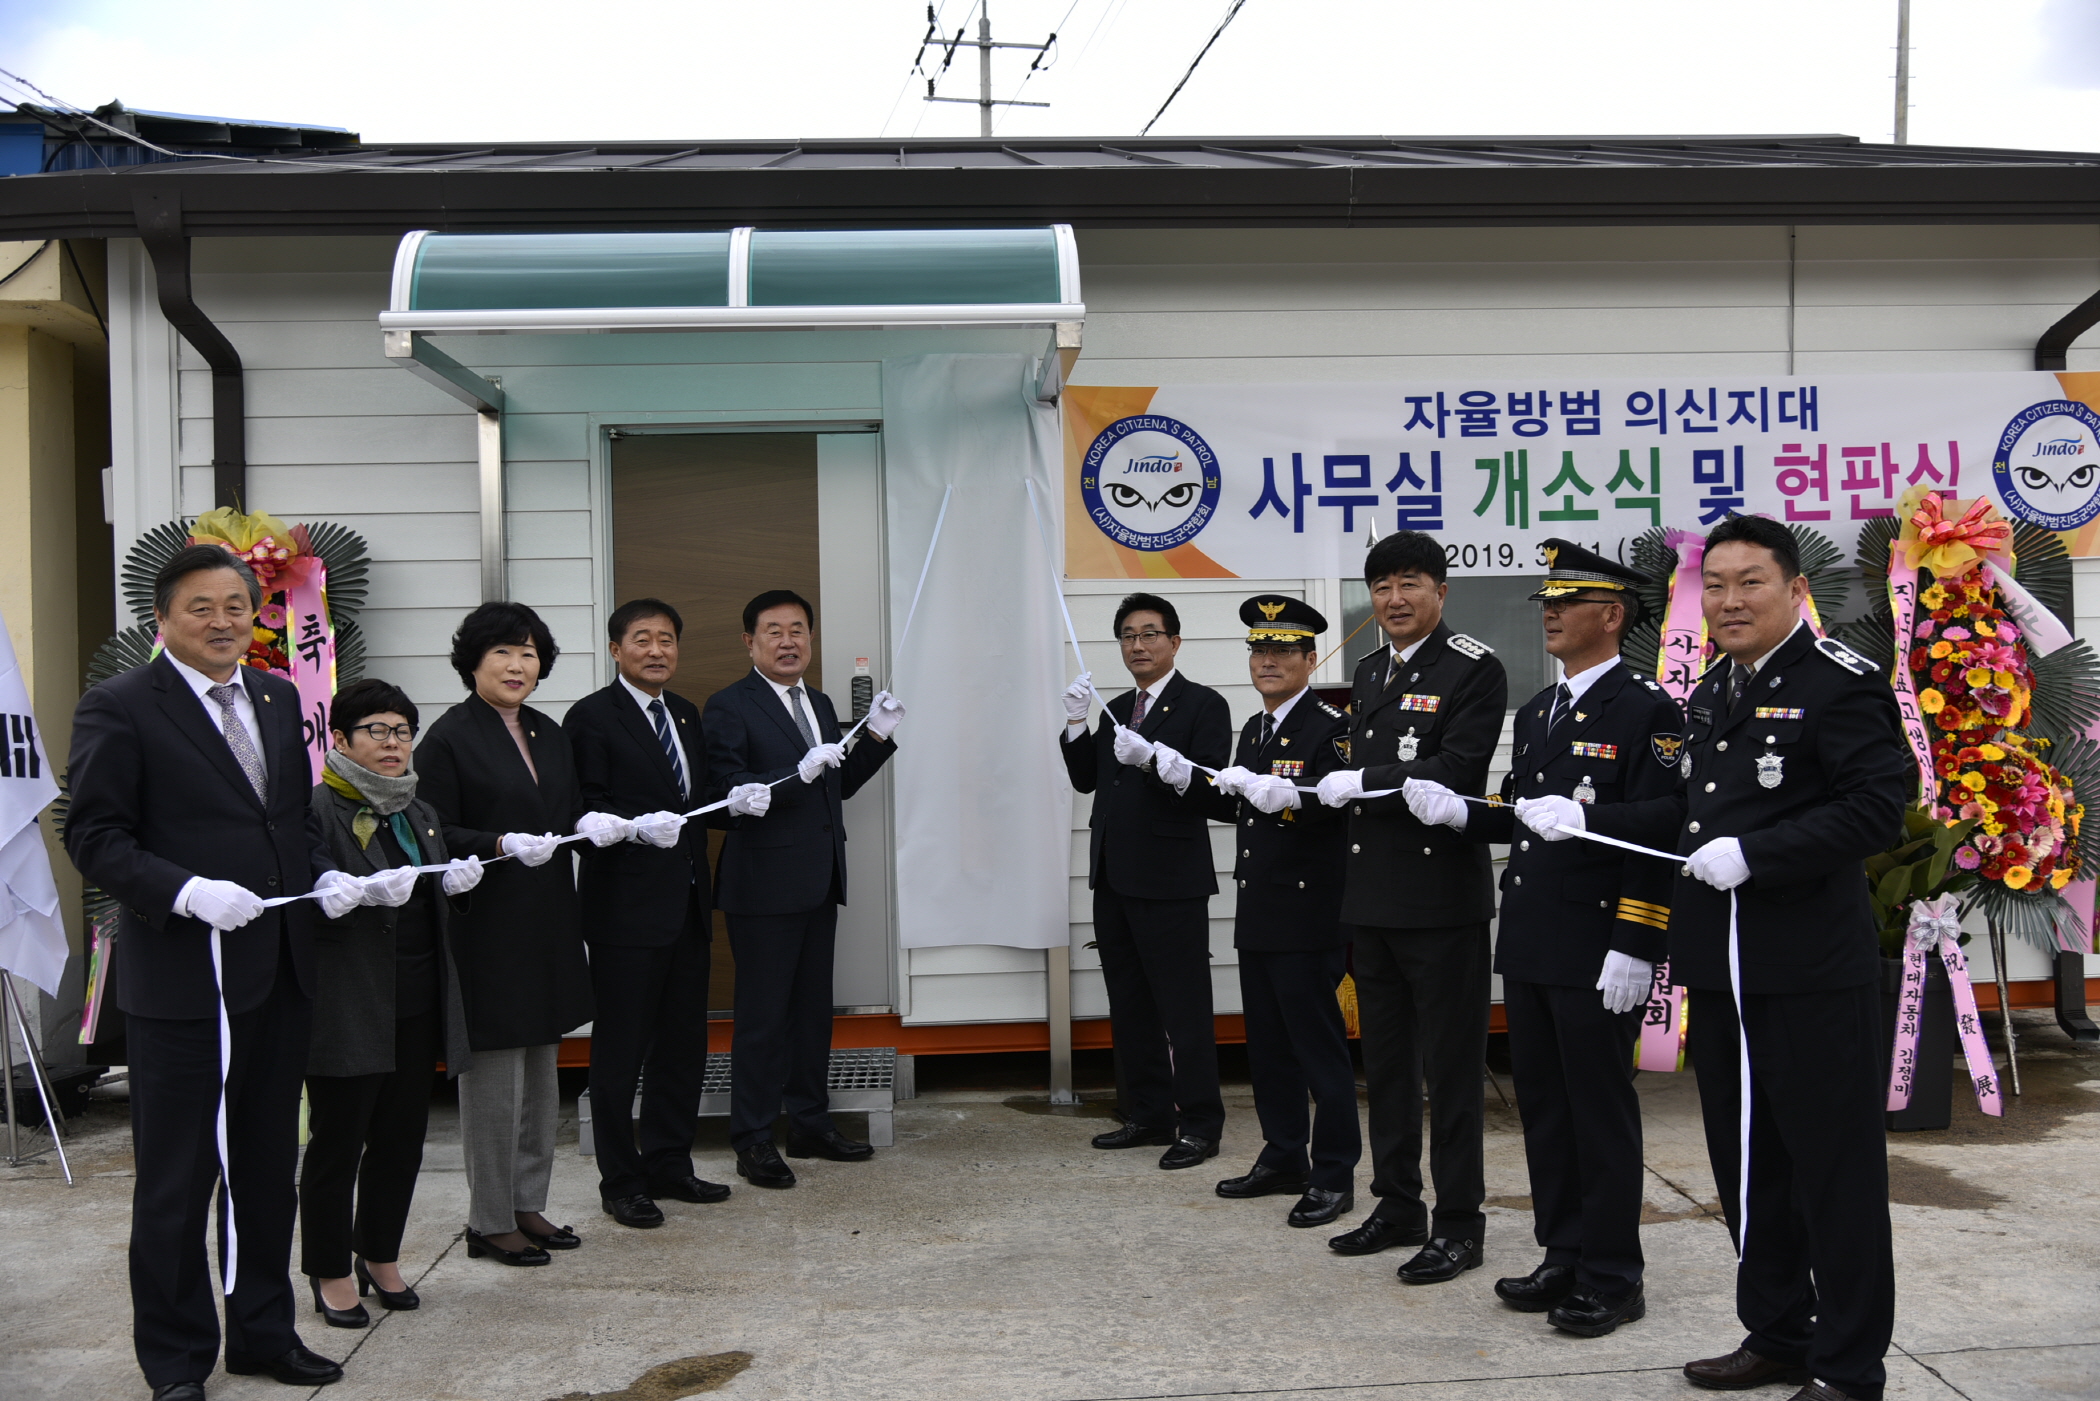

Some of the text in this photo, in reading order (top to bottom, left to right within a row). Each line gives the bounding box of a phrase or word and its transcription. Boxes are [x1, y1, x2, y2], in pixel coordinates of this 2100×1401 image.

[1404, 386, 1818, 438] 자율방범 의신지대
[2000, 418, 2029, 451] KOREA
[2026, 403, 2085, 422] CITIZENA'S
[1087, 419, 1213, 468] KOREA CITIZENA'S PATROL
[1123, 459, 1172, 474] Jindo
[1994, 461, 2006, 474] 전
[2032, 442, 2077, 457] Jindo
[1083, 476, 1218, 489] 전 남
[1248, 441, 1960, 533] 사무실 개소식 및 현판식
[1092, 503, 1212, 549] (사)자율방범진도군연합회
[296, 614, 327, 674] 축
[1894, 952, 1921, 1097] 현대자동차 김정미
